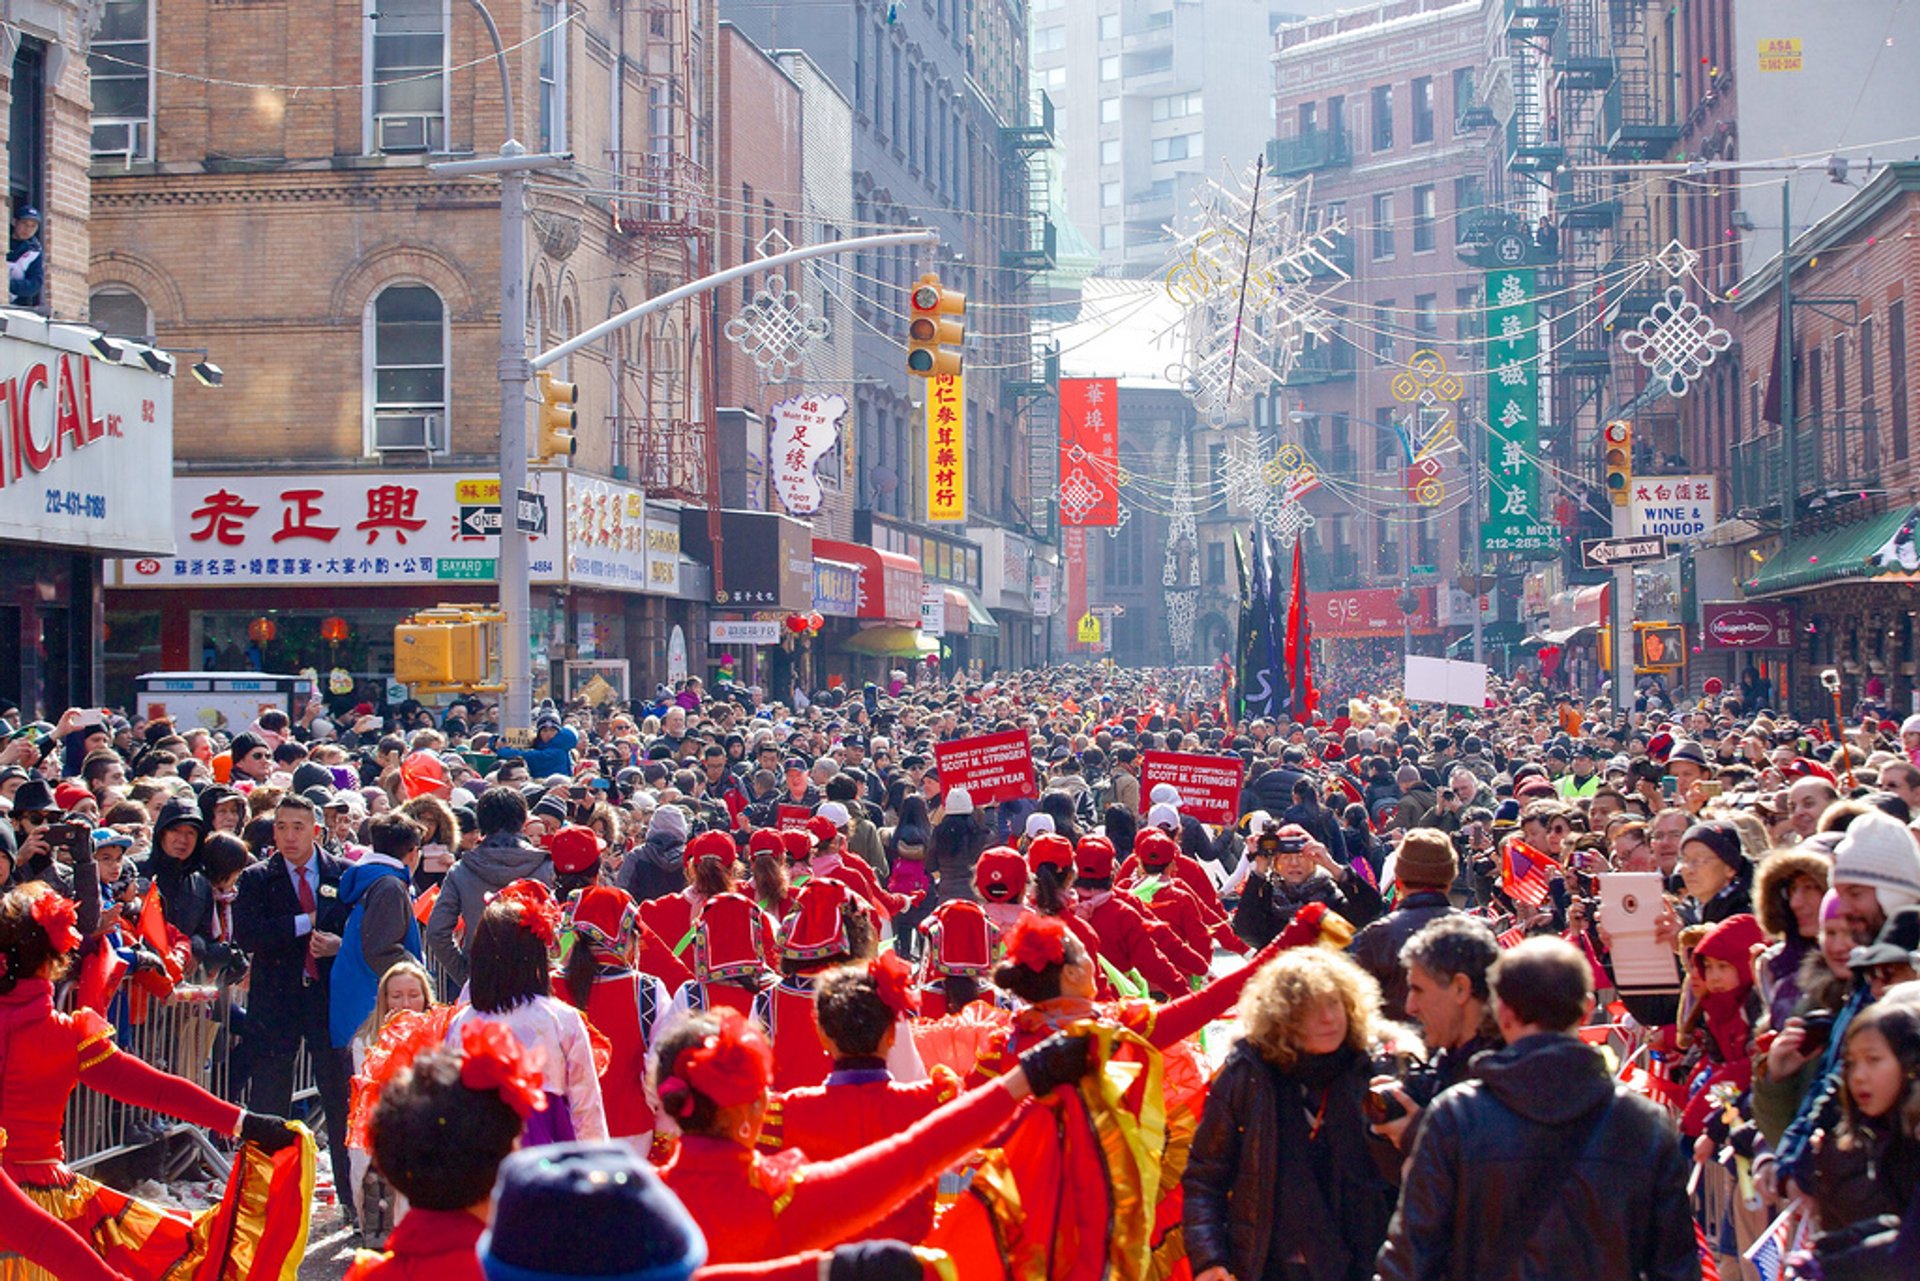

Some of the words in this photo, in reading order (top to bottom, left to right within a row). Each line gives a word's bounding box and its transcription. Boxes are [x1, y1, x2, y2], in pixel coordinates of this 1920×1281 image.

[801, 401, 818, 413] 48
[190, 484, 427, 546] 老正興
[1645, 508, 1684, 520] WINE
[1691, 508, 1701, 519] &
[472, 515, 498, 527] ONE
[1629, 543, 1655, 555] WAY
[442, 561, 482, 571] BAYARD
[166, 681, 194, 690] TITAN
[232, 681, 260, 690] TITAN
[942, 759, 969, 772] SCOTT
[971, 757, 981, 767] M.
[982, 749, 1027, 765] STRINGER
[980, 776, 1000, 788] NEW
[1001, 772, 1025, 785] YEAR
[1148, 770, 1177, 781] SCOTT
[1179, 773, 1189, 782] M.
[1191, 774, 1237, 787] STRINGER
[1205, 798, 1229, 810] YEAR
